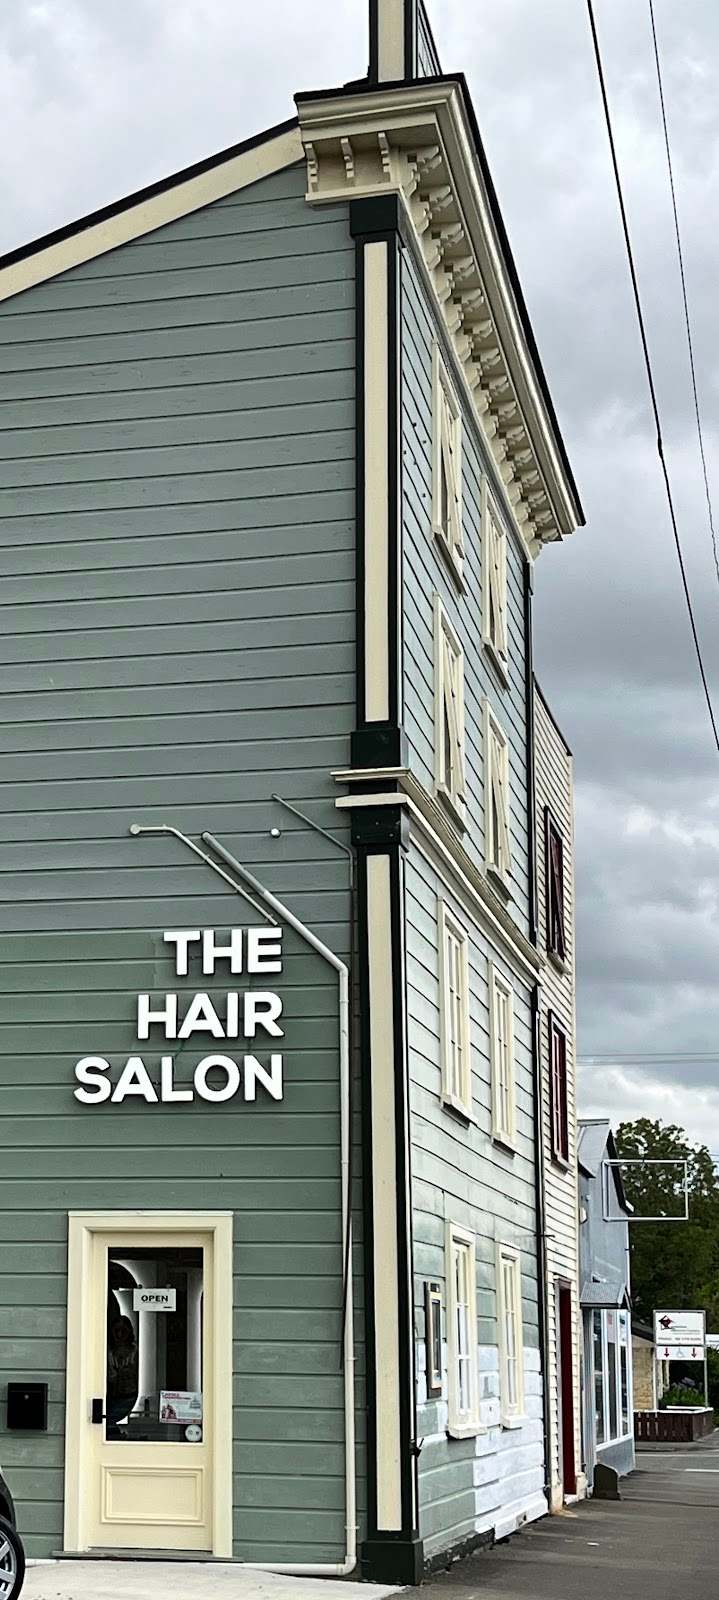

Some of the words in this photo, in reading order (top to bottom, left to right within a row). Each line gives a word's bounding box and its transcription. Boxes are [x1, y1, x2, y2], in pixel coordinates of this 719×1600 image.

[163, 927, 283, 976] THE
[137, 991, 285, 1040] HAIR
[73, 1054, 284, 1104] SALON
[141, 1294, 168, 1302] OPEN
